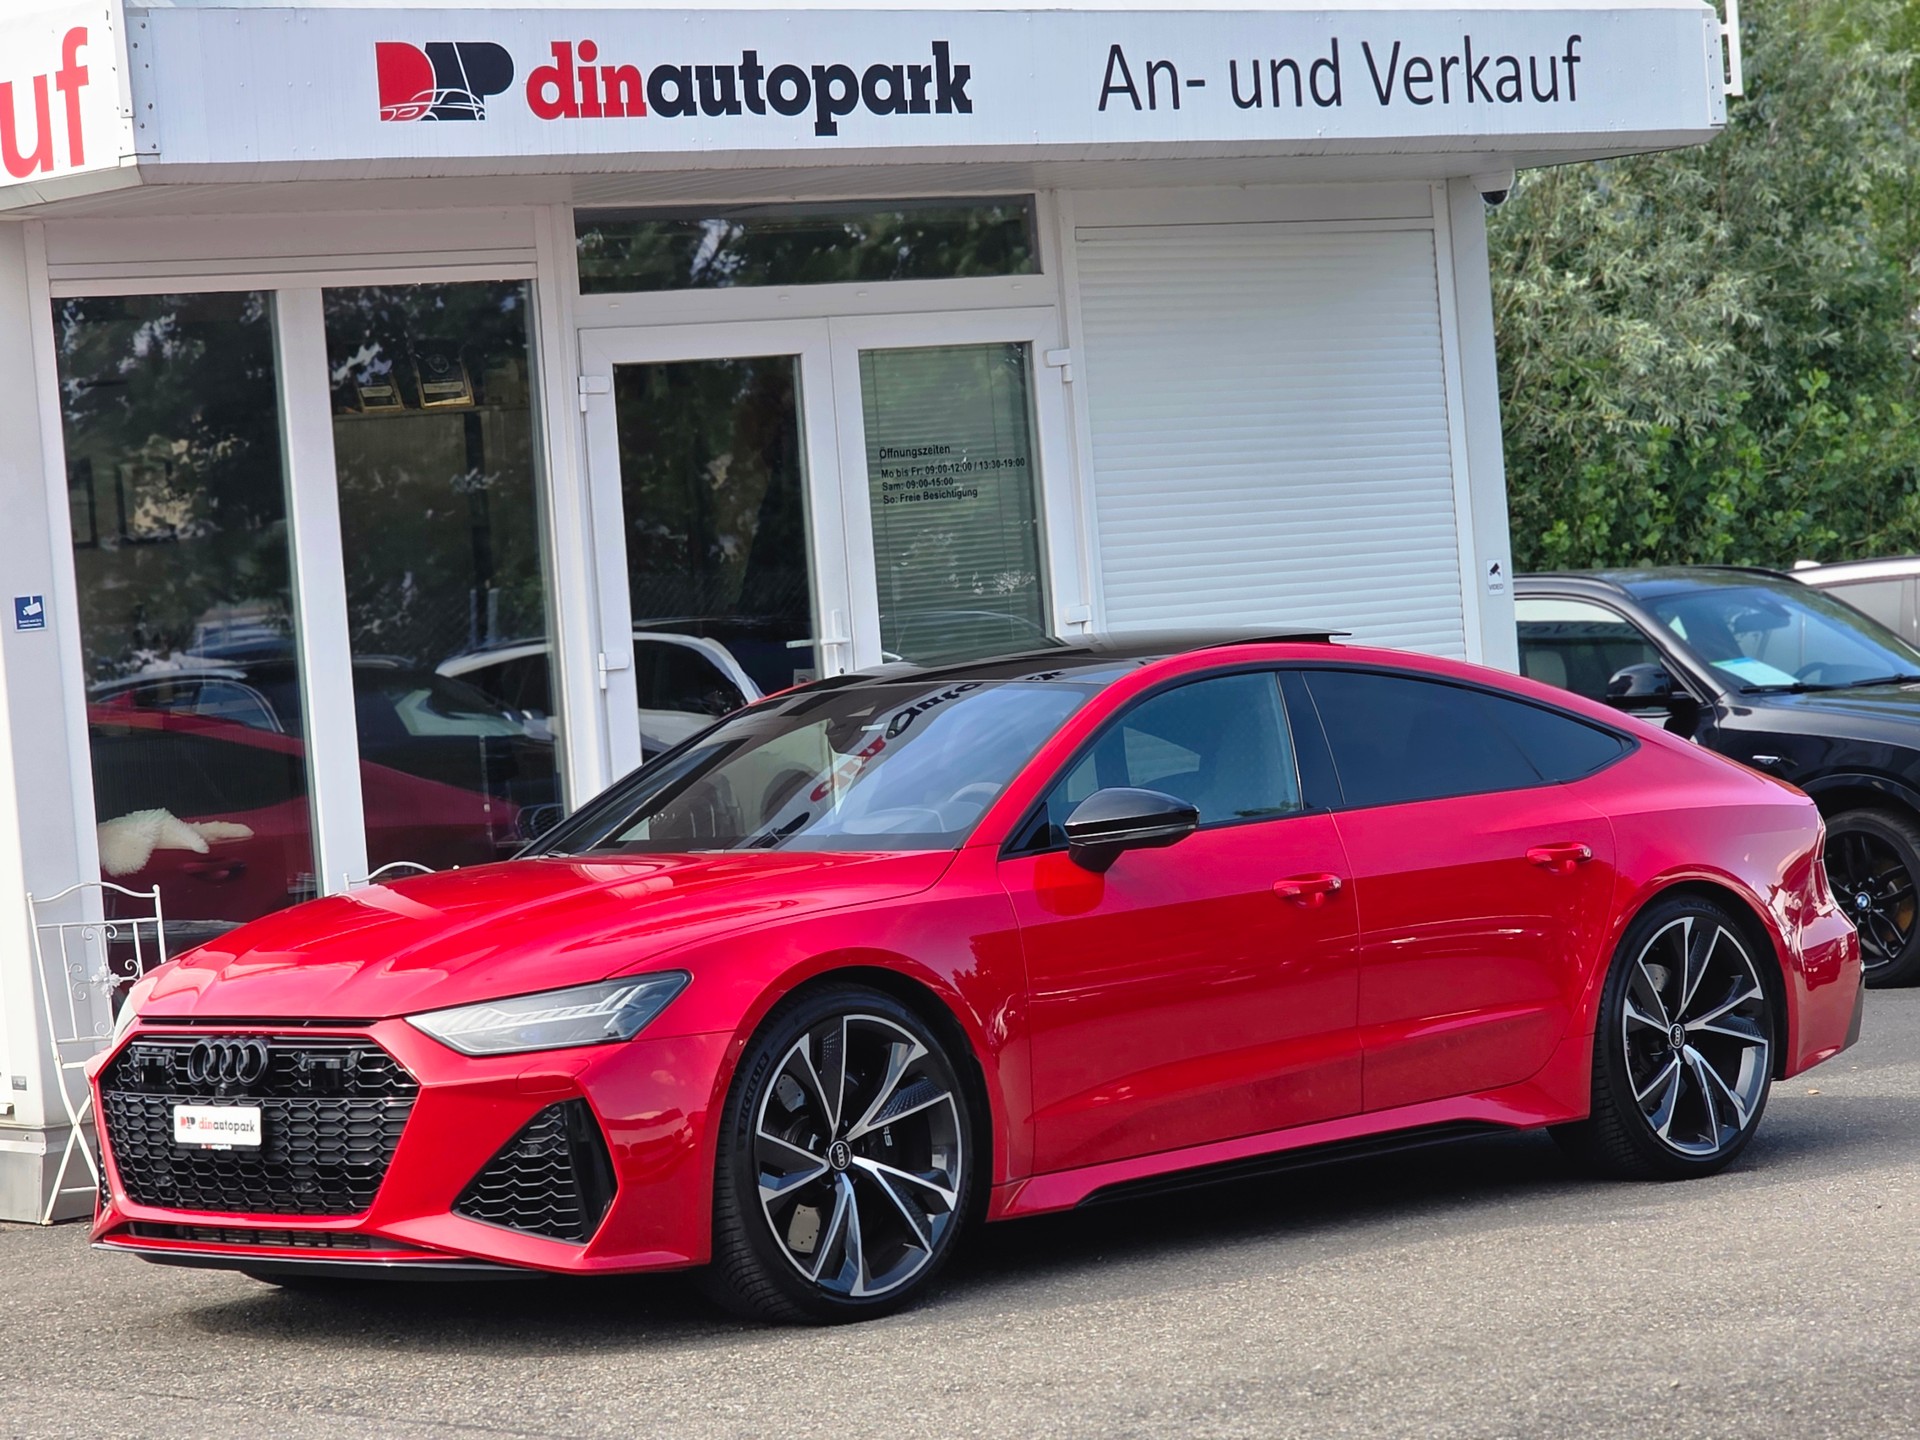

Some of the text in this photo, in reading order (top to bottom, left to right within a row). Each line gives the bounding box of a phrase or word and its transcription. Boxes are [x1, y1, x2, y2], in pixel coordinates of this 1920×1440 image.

[1098, 35, 1582, 111] An- und Verkauf
[526, 39, 973, 136] dinautopark
[879, 445, 950, 459] Öffnungszeiten
[881, 468, 894, 479] Mo
[895, 468, 909, 478] bis
[925, 462, 972, 475] 09:00-12:00
[979, 457, 1025, 471] 13:30-19:00
[882, 476, 954, 492] Sam: 09:00-15:00
[883, 488, 978, 505] So: Freie Besichtigung
[199, 1118, 255, 1134] dinautopark
